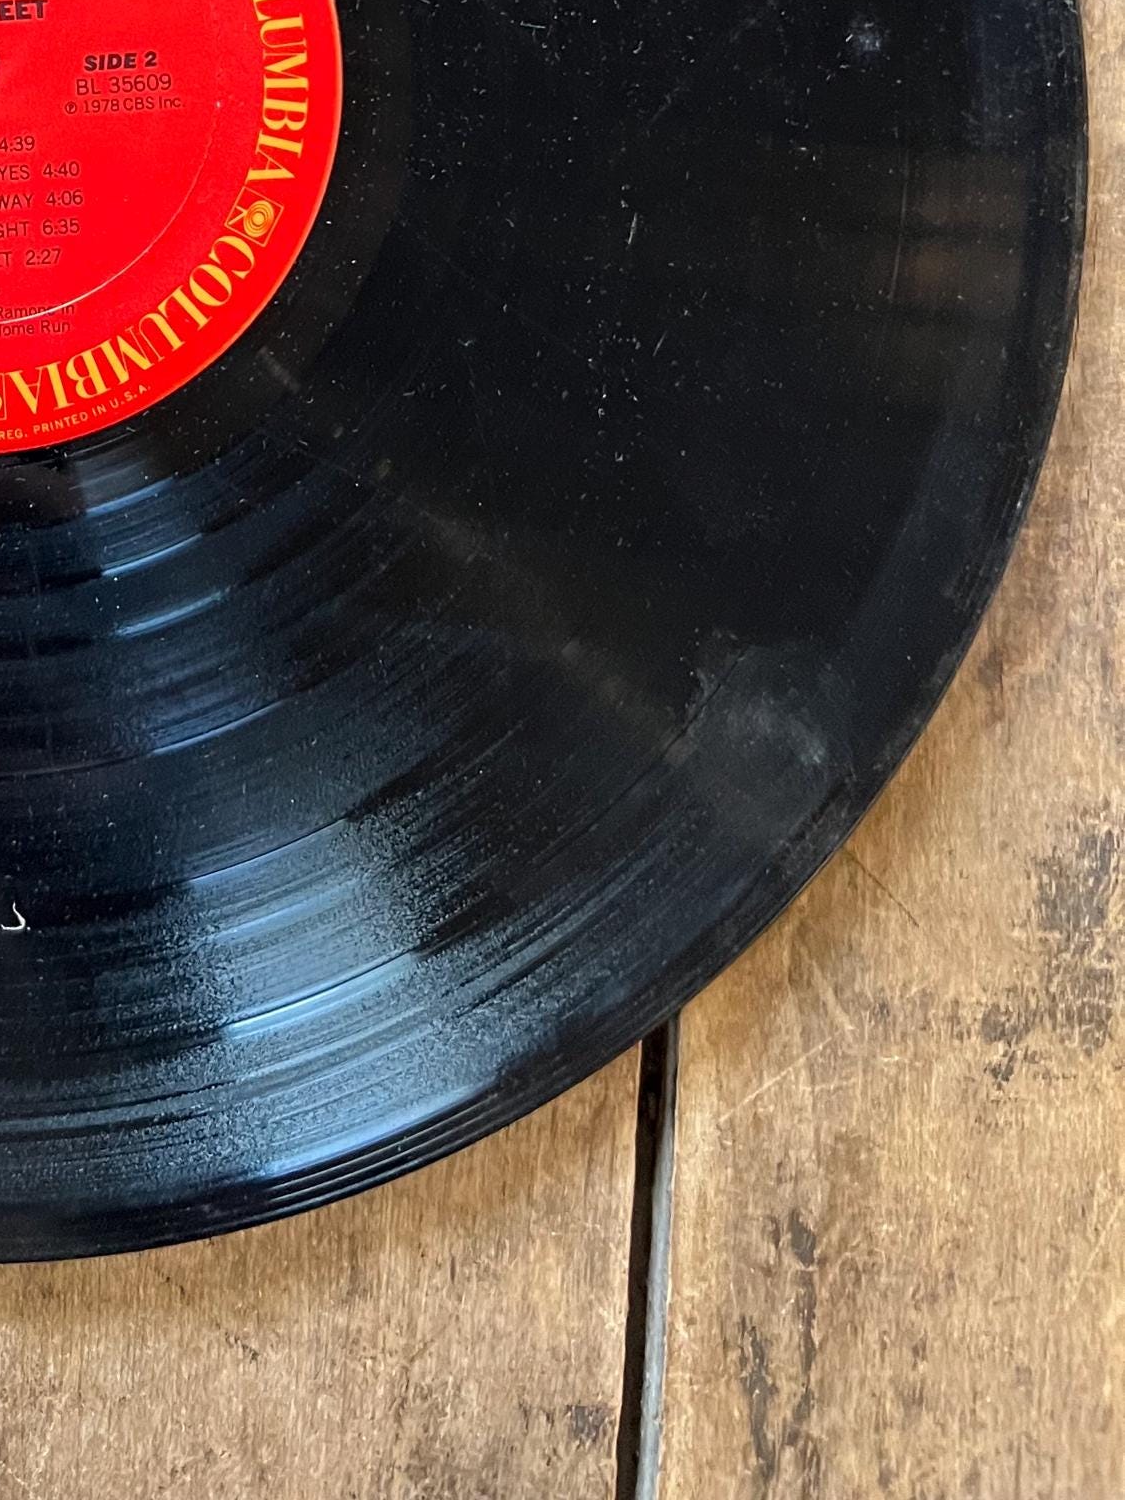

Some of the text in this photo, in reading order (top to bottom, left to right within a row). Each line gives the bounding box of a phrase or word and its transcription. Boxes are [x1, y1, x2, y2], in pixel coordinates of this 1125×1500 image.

[84, 51, 157, 72] SIDE 2
[76, 73, 172, 96] BL 35609
[84, 99, 120, 113] 1978
[123, 96, 154, 111] CBS
[159, 96, 185, 108] Inc.
[43, 162, 80, 178] 4:40
[45, 191, 83, 206] 4:06
[43, 218, 80, 235] 6:35
[26, 248, 62, 266] 2:27
[9, 236, 256, 414] COLUMBIA
[41, 320, 71, 333] Run
[33, 411, 88, 434] PRINTED
[93, 407, 107, 417] IN
[110, 385, 151, 410] U.S.A.
